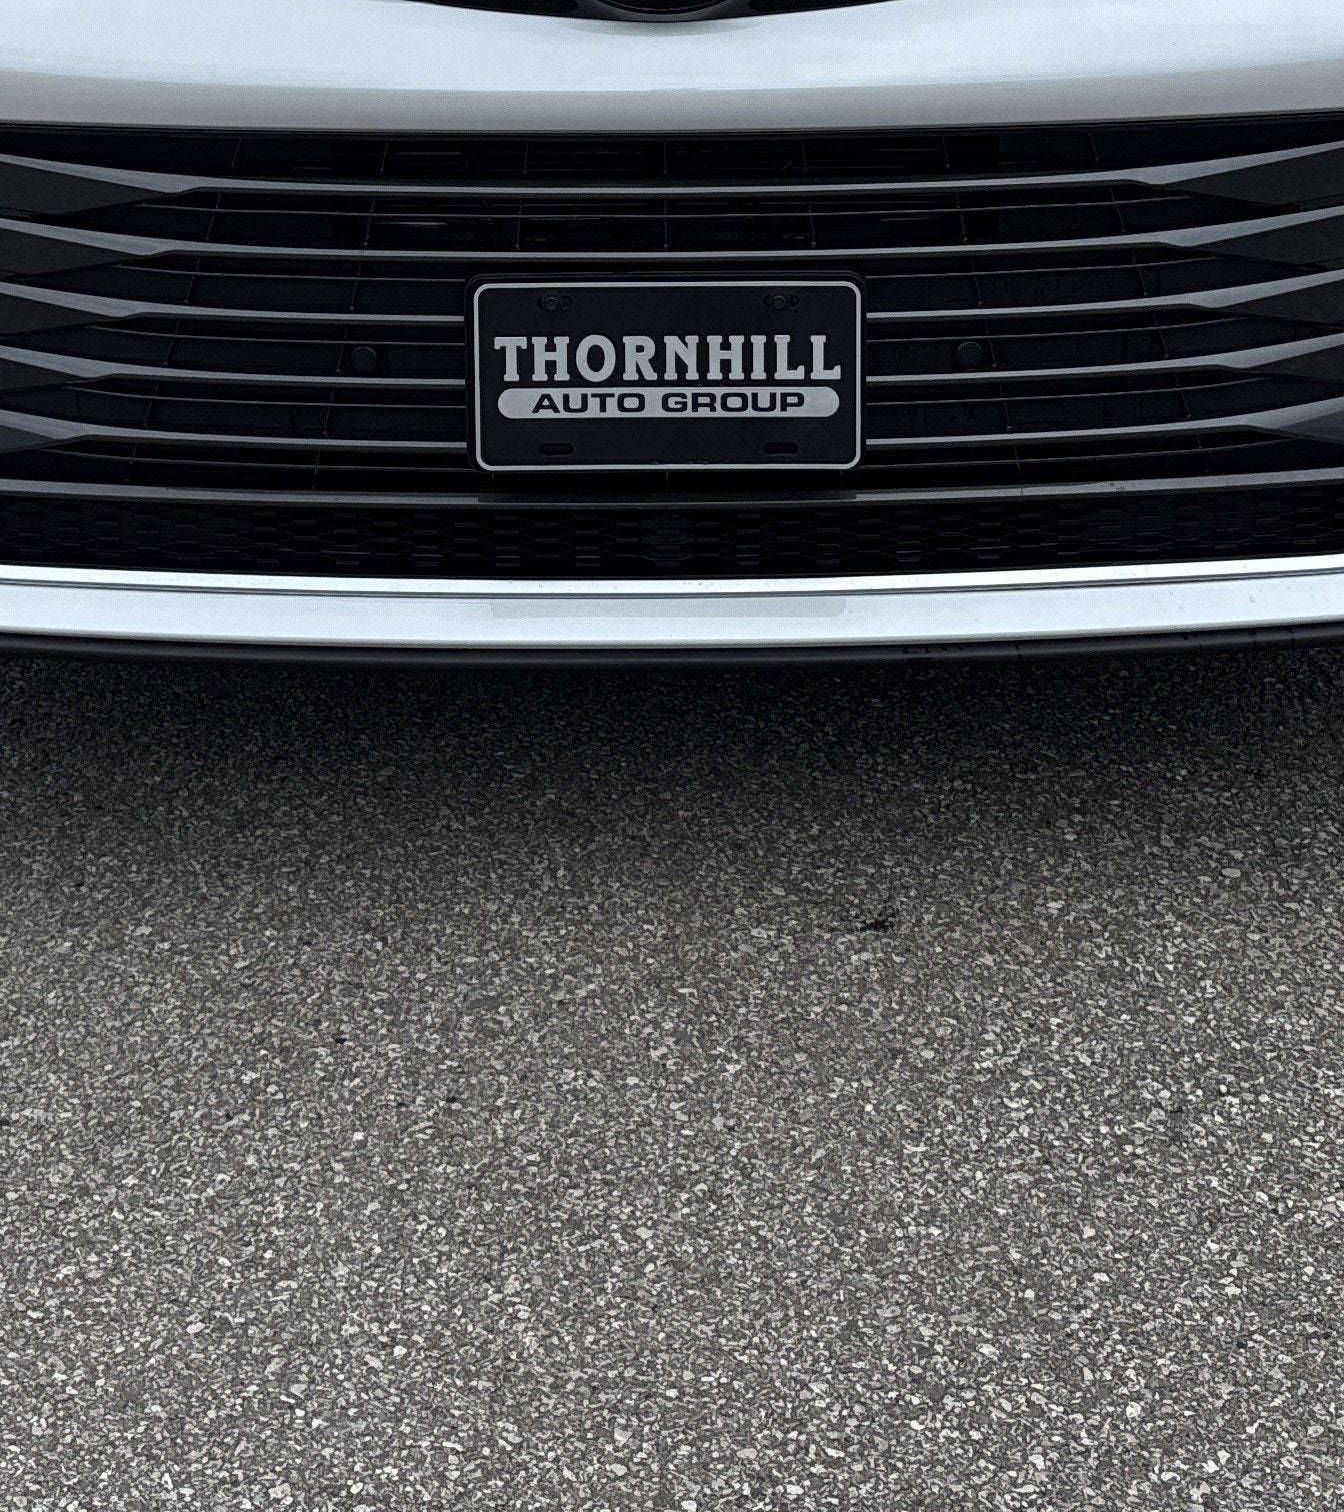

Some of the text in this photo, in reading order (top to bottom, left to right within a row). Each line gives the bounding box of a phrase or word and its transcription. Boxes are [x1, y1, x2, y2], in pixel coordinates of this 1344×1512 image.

[493, 334, 842, 383] THORNHILL
[532, 392, 805, 414] AUTO GROUP
